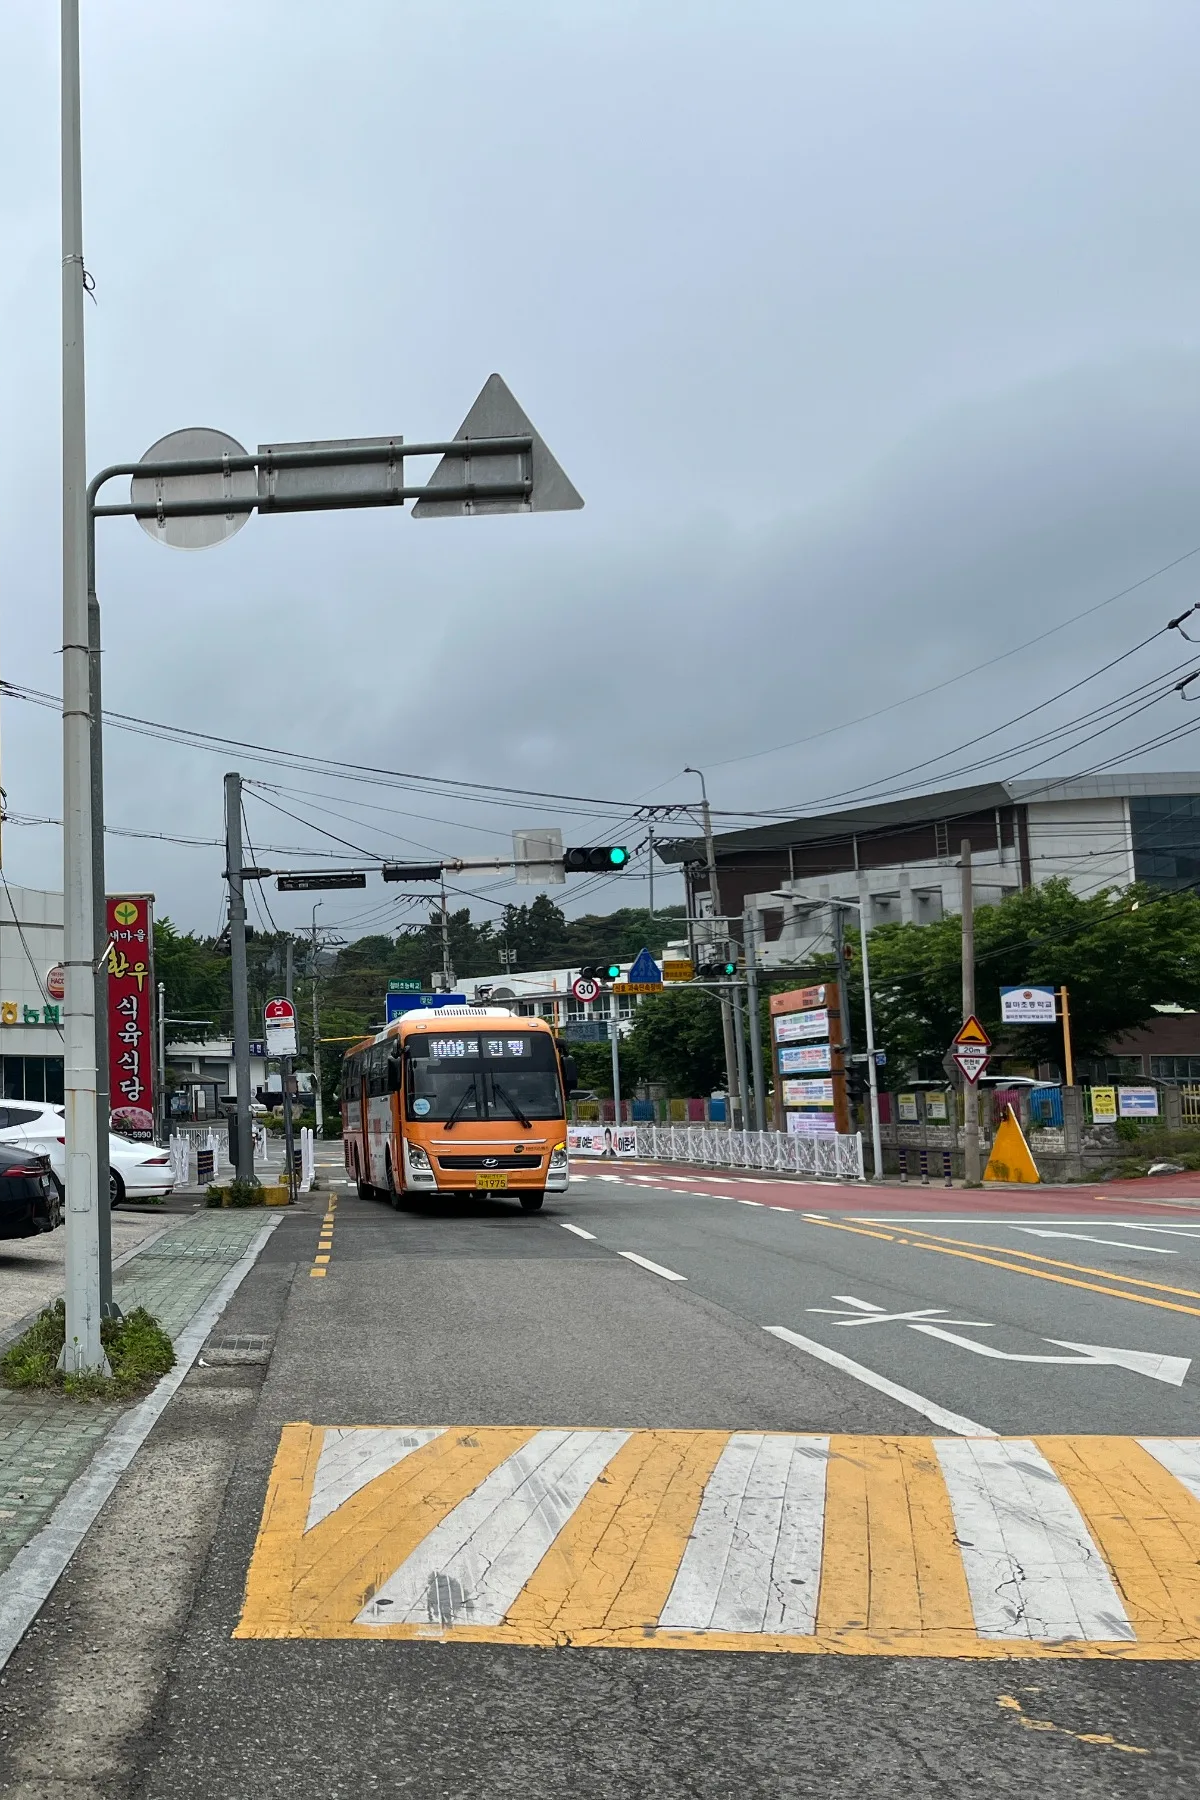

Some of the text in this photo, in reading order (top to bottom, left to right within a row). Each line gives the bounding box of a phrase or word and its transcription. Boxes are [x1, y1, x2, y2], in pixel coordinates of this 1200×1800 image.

[108, 948, 149, 992] 한우
[578, 984, 594, 995] 30
[1004, 1001, 1052, 1009] 철마초등학교
[23, 1004, 60, 1025] 농협
[430, 1039, 466, 1057] 1008
